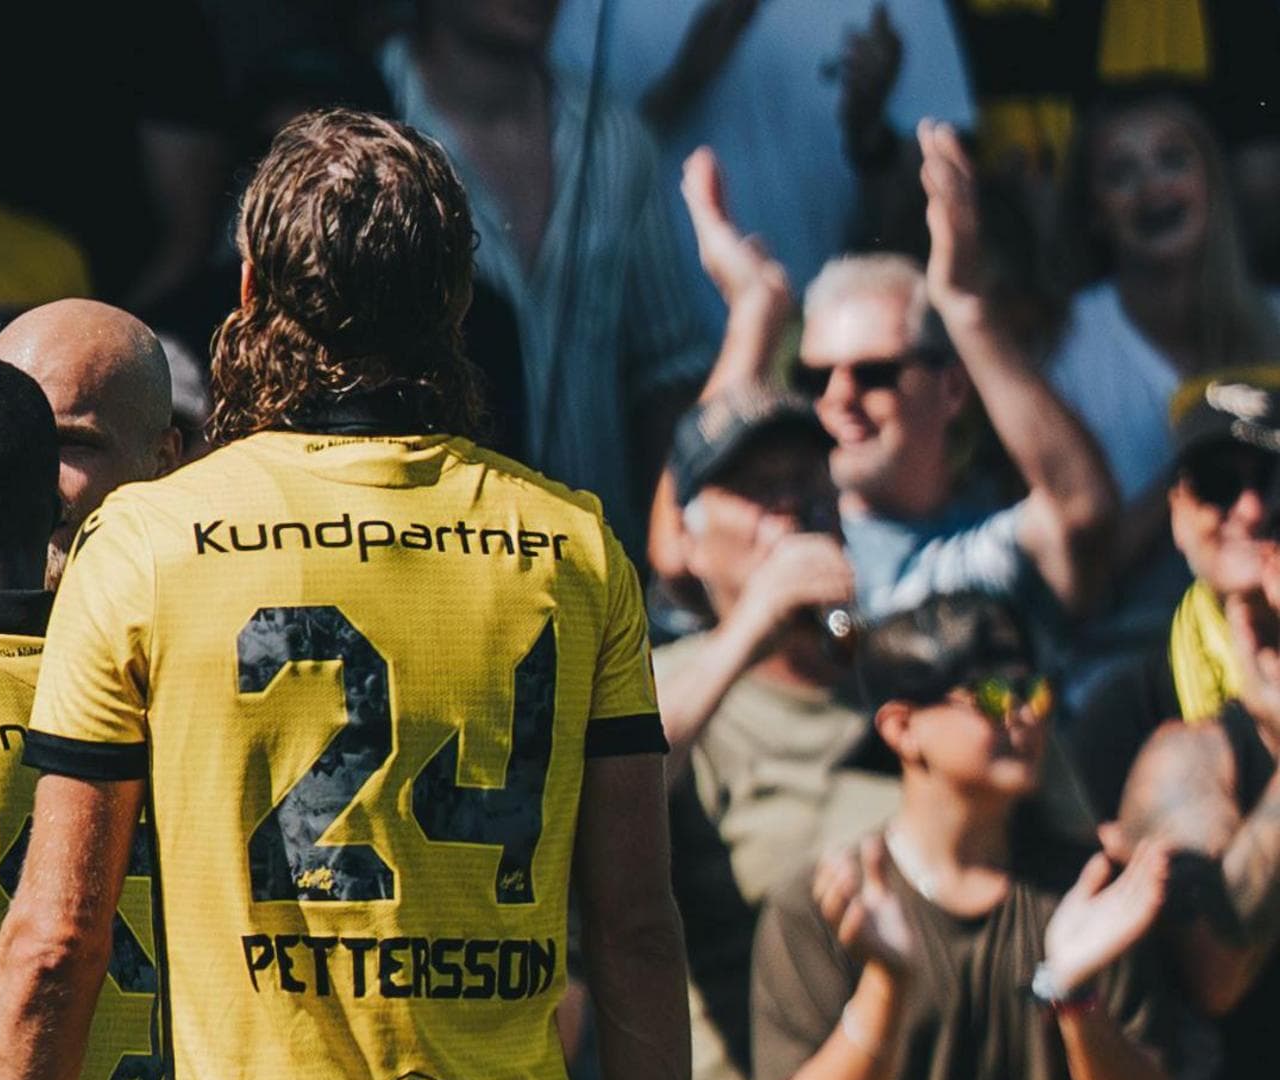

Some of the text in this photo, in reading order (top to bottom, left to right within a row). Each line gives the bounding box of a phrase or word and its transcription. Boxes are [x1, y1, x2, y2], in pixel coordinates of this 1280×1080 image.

[193, 513, 569, 562] Kundpartner
[237, 604, 558, 905] 24
[240, 933, 557, 1000] PETTERSSON
